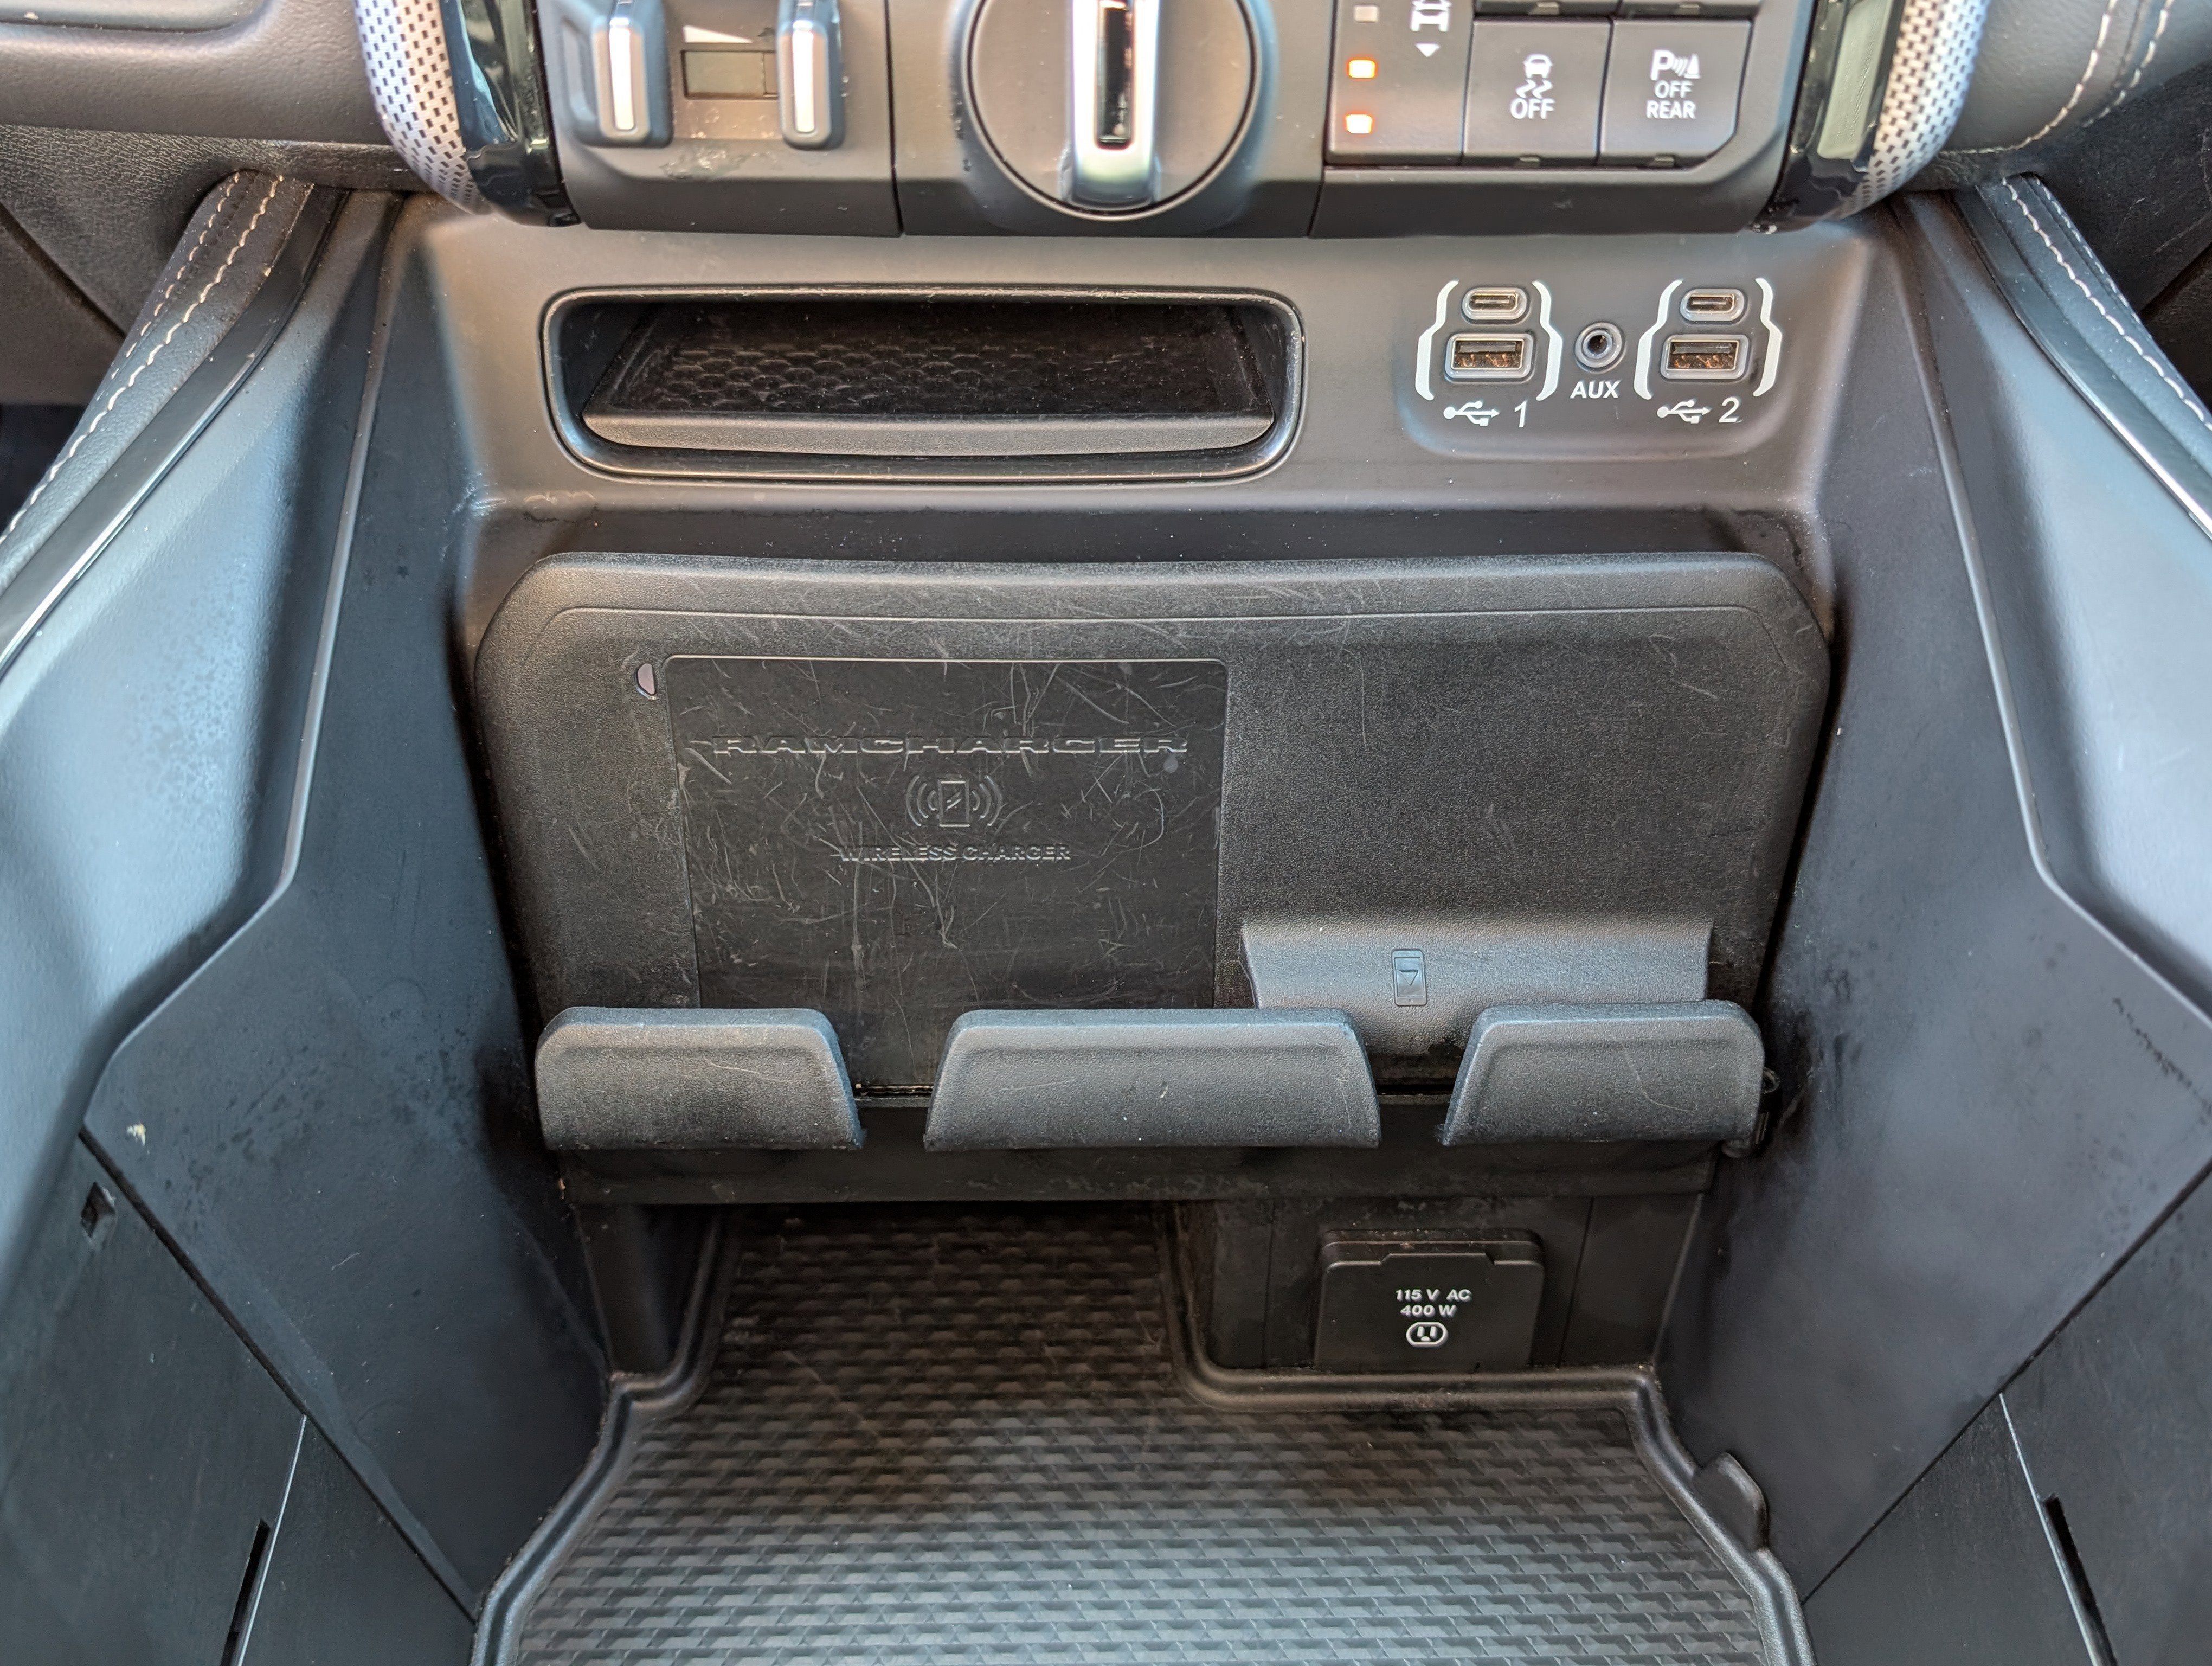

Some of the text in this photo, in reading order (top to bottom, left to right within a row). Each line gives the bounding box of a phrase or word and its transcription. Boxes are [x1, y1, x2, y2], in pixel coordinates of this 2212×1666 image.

[1654, 81, 1693, 98] OFF
[1510, 98, 1555, 119] OFF
[1646, 100, 1696, 119] REAR
[1570, 381, 1621, 399] AUX
[1514, 401, 1528, 428] 1
[1718, 396, 1742, 423] 2
[712, 736, 1188, 754] RAMCHARGER
[839, 844, 1071, 862] WIRELESS CHARGER
[1396, 1289, 1472, 1302] 115 V AC
[1400, 1304, 1457, 1317] 400 W
